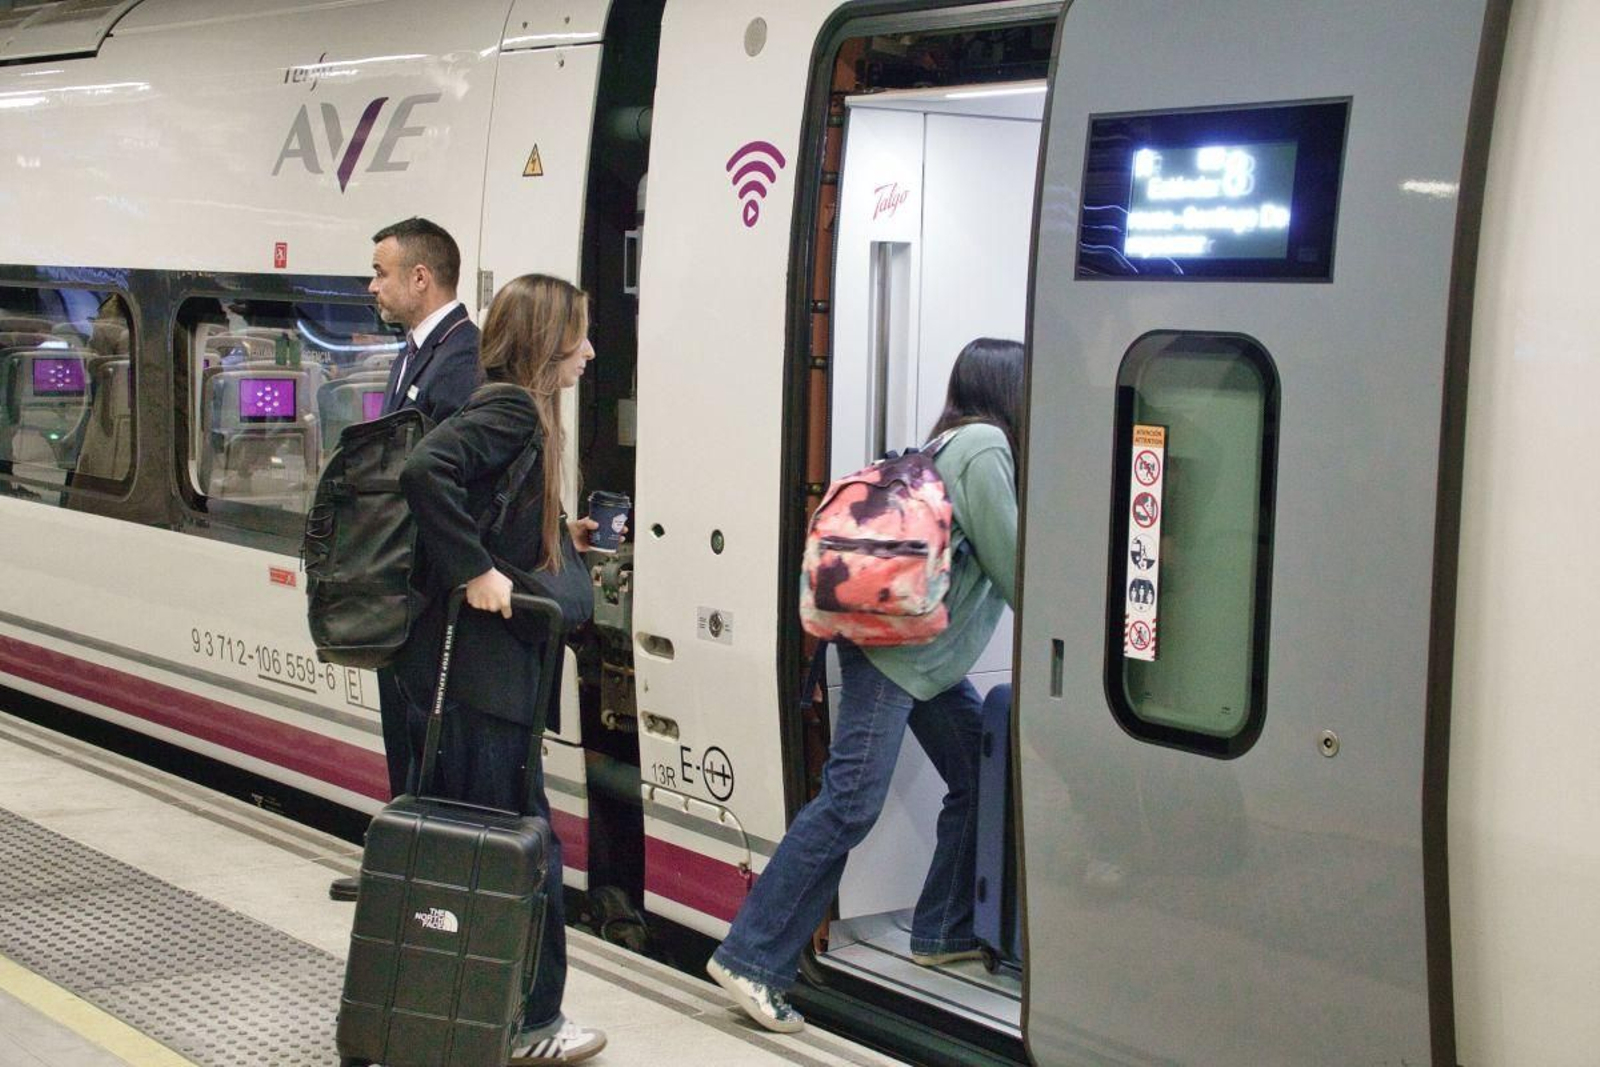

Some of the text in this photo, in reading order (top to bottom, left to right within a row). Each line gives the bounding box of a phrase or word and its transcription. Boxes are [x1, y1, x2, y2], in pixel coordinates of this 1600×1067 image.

[271, 92, 442, 195] AVE
[872, 182, 911, 221] Talgo
[445, 625, 453, 651] NEVER
[346, 668, 359, 701] E
[651, 762, 677, 788] 13R
[414, 912, 445, 922] NORTH
[421, 919, 445, 930] FACE
[429, 908, 445, 916] THE
